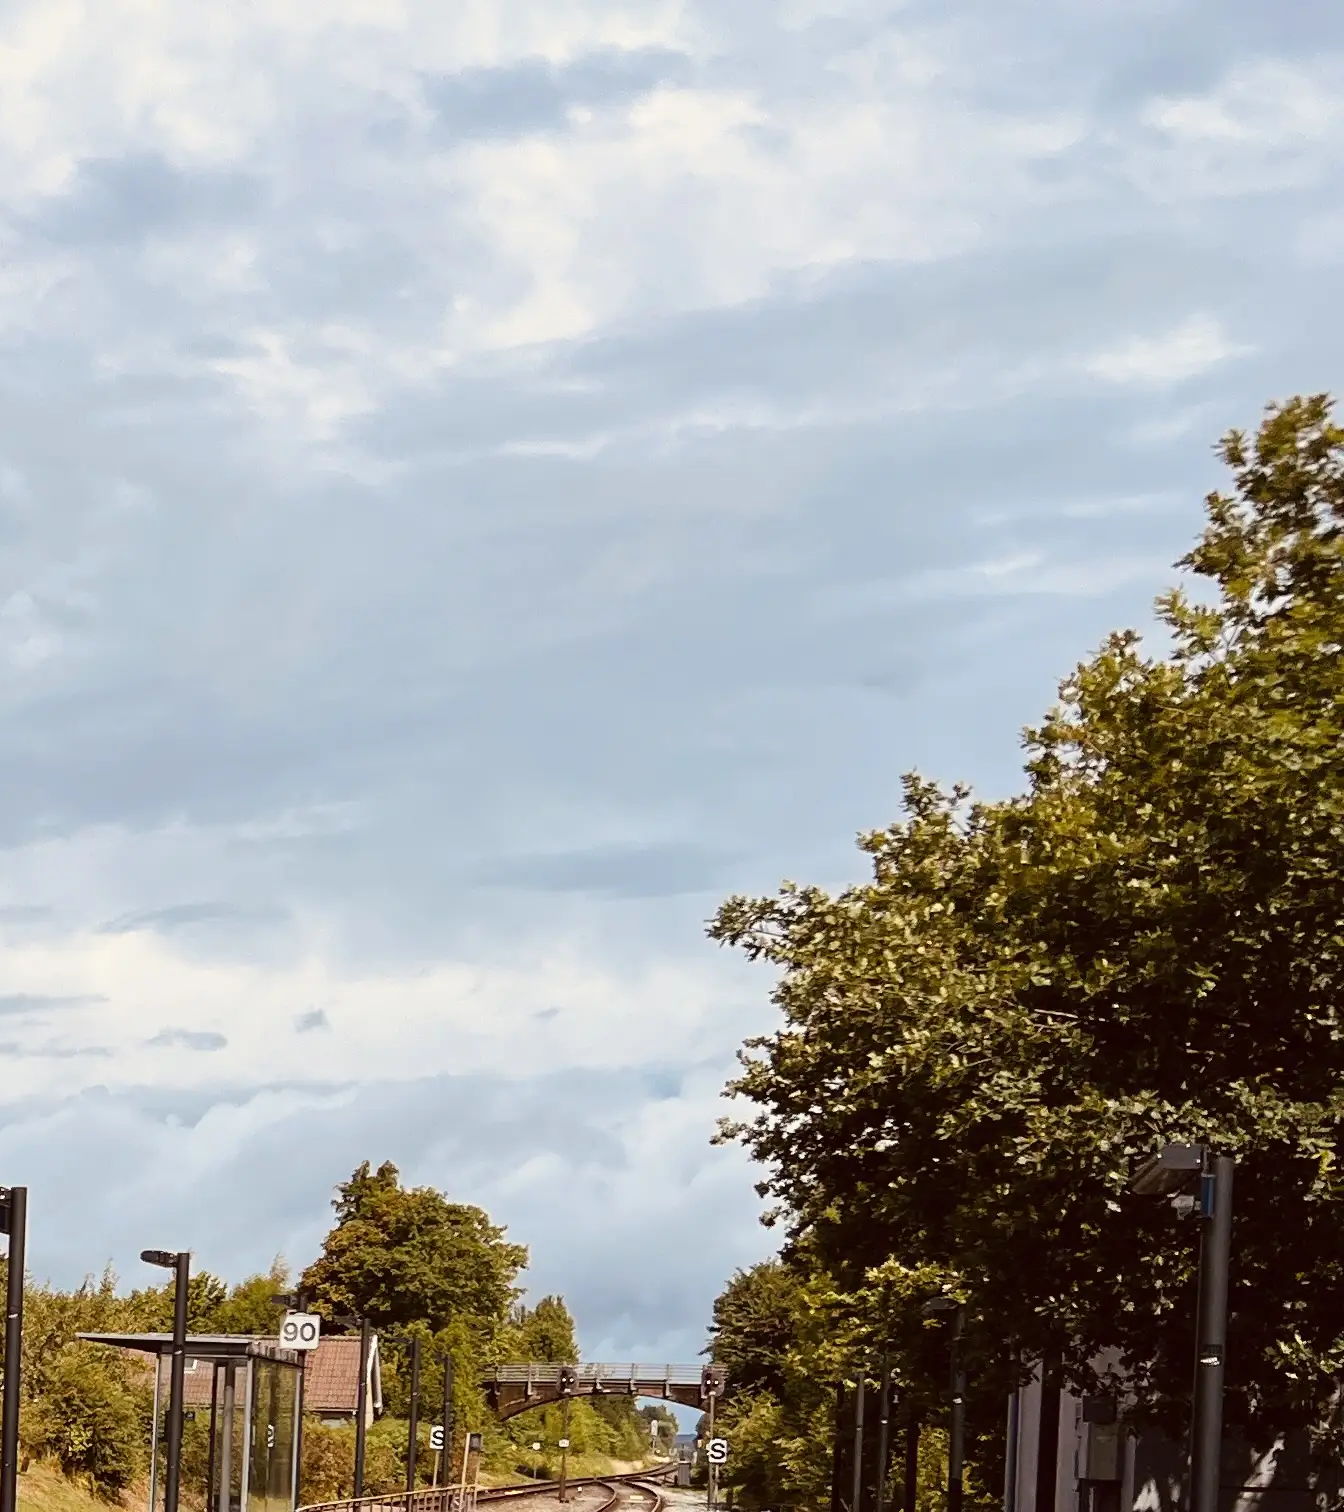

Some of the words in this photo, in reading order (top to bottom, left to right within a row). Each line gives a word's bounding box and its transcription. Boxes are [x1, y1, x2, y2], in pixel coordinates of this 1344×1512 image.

[283, 1322, 316, 1341] 90
[431, 1430, 444, 1446] S
[710, 1442, 726, 1460] S
